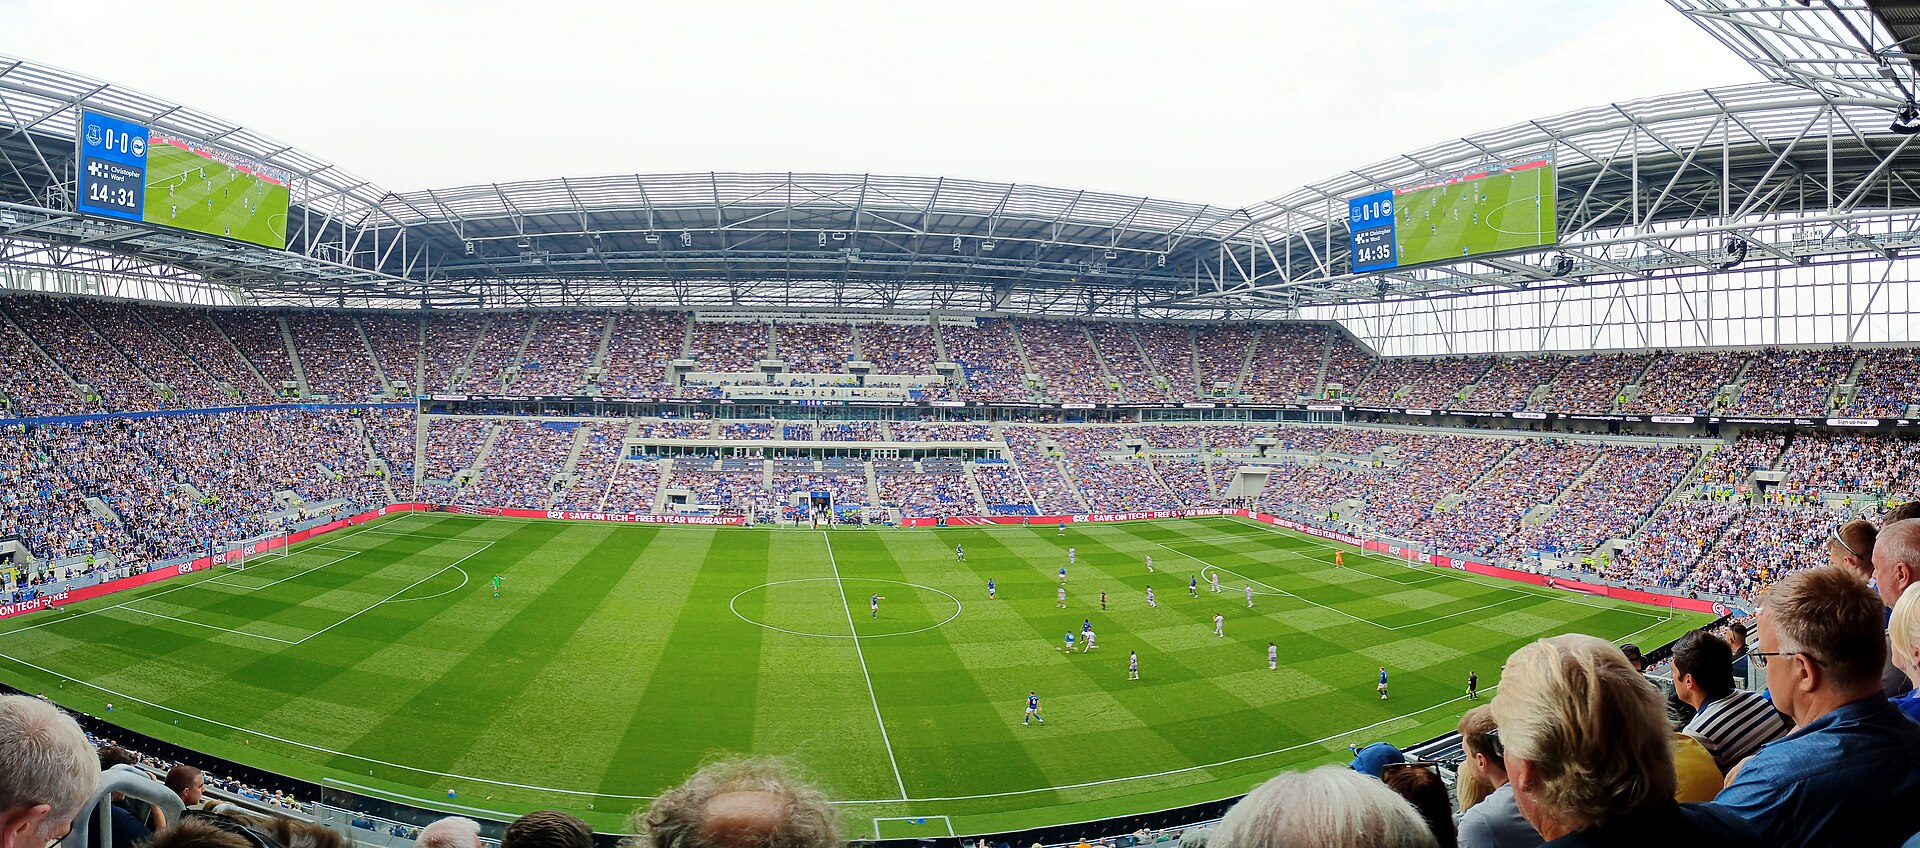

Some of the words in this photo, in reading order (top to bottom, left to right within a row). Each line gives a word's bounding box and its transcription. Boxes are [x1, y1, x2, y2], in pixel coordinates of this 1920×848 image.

[110, 166, 140, 178] Christopher
[110, 174, 125, 182] Ward
[90, 182, 136, 208] 14:31
[1358, 244, 1390, 262] 14:35
[1128, 512, 1147, 520] TECH
[1323, 531, 1336, 539] YEAR
[0, 604, 14, 616] ON
[16, 599, 40, 612] TECH
